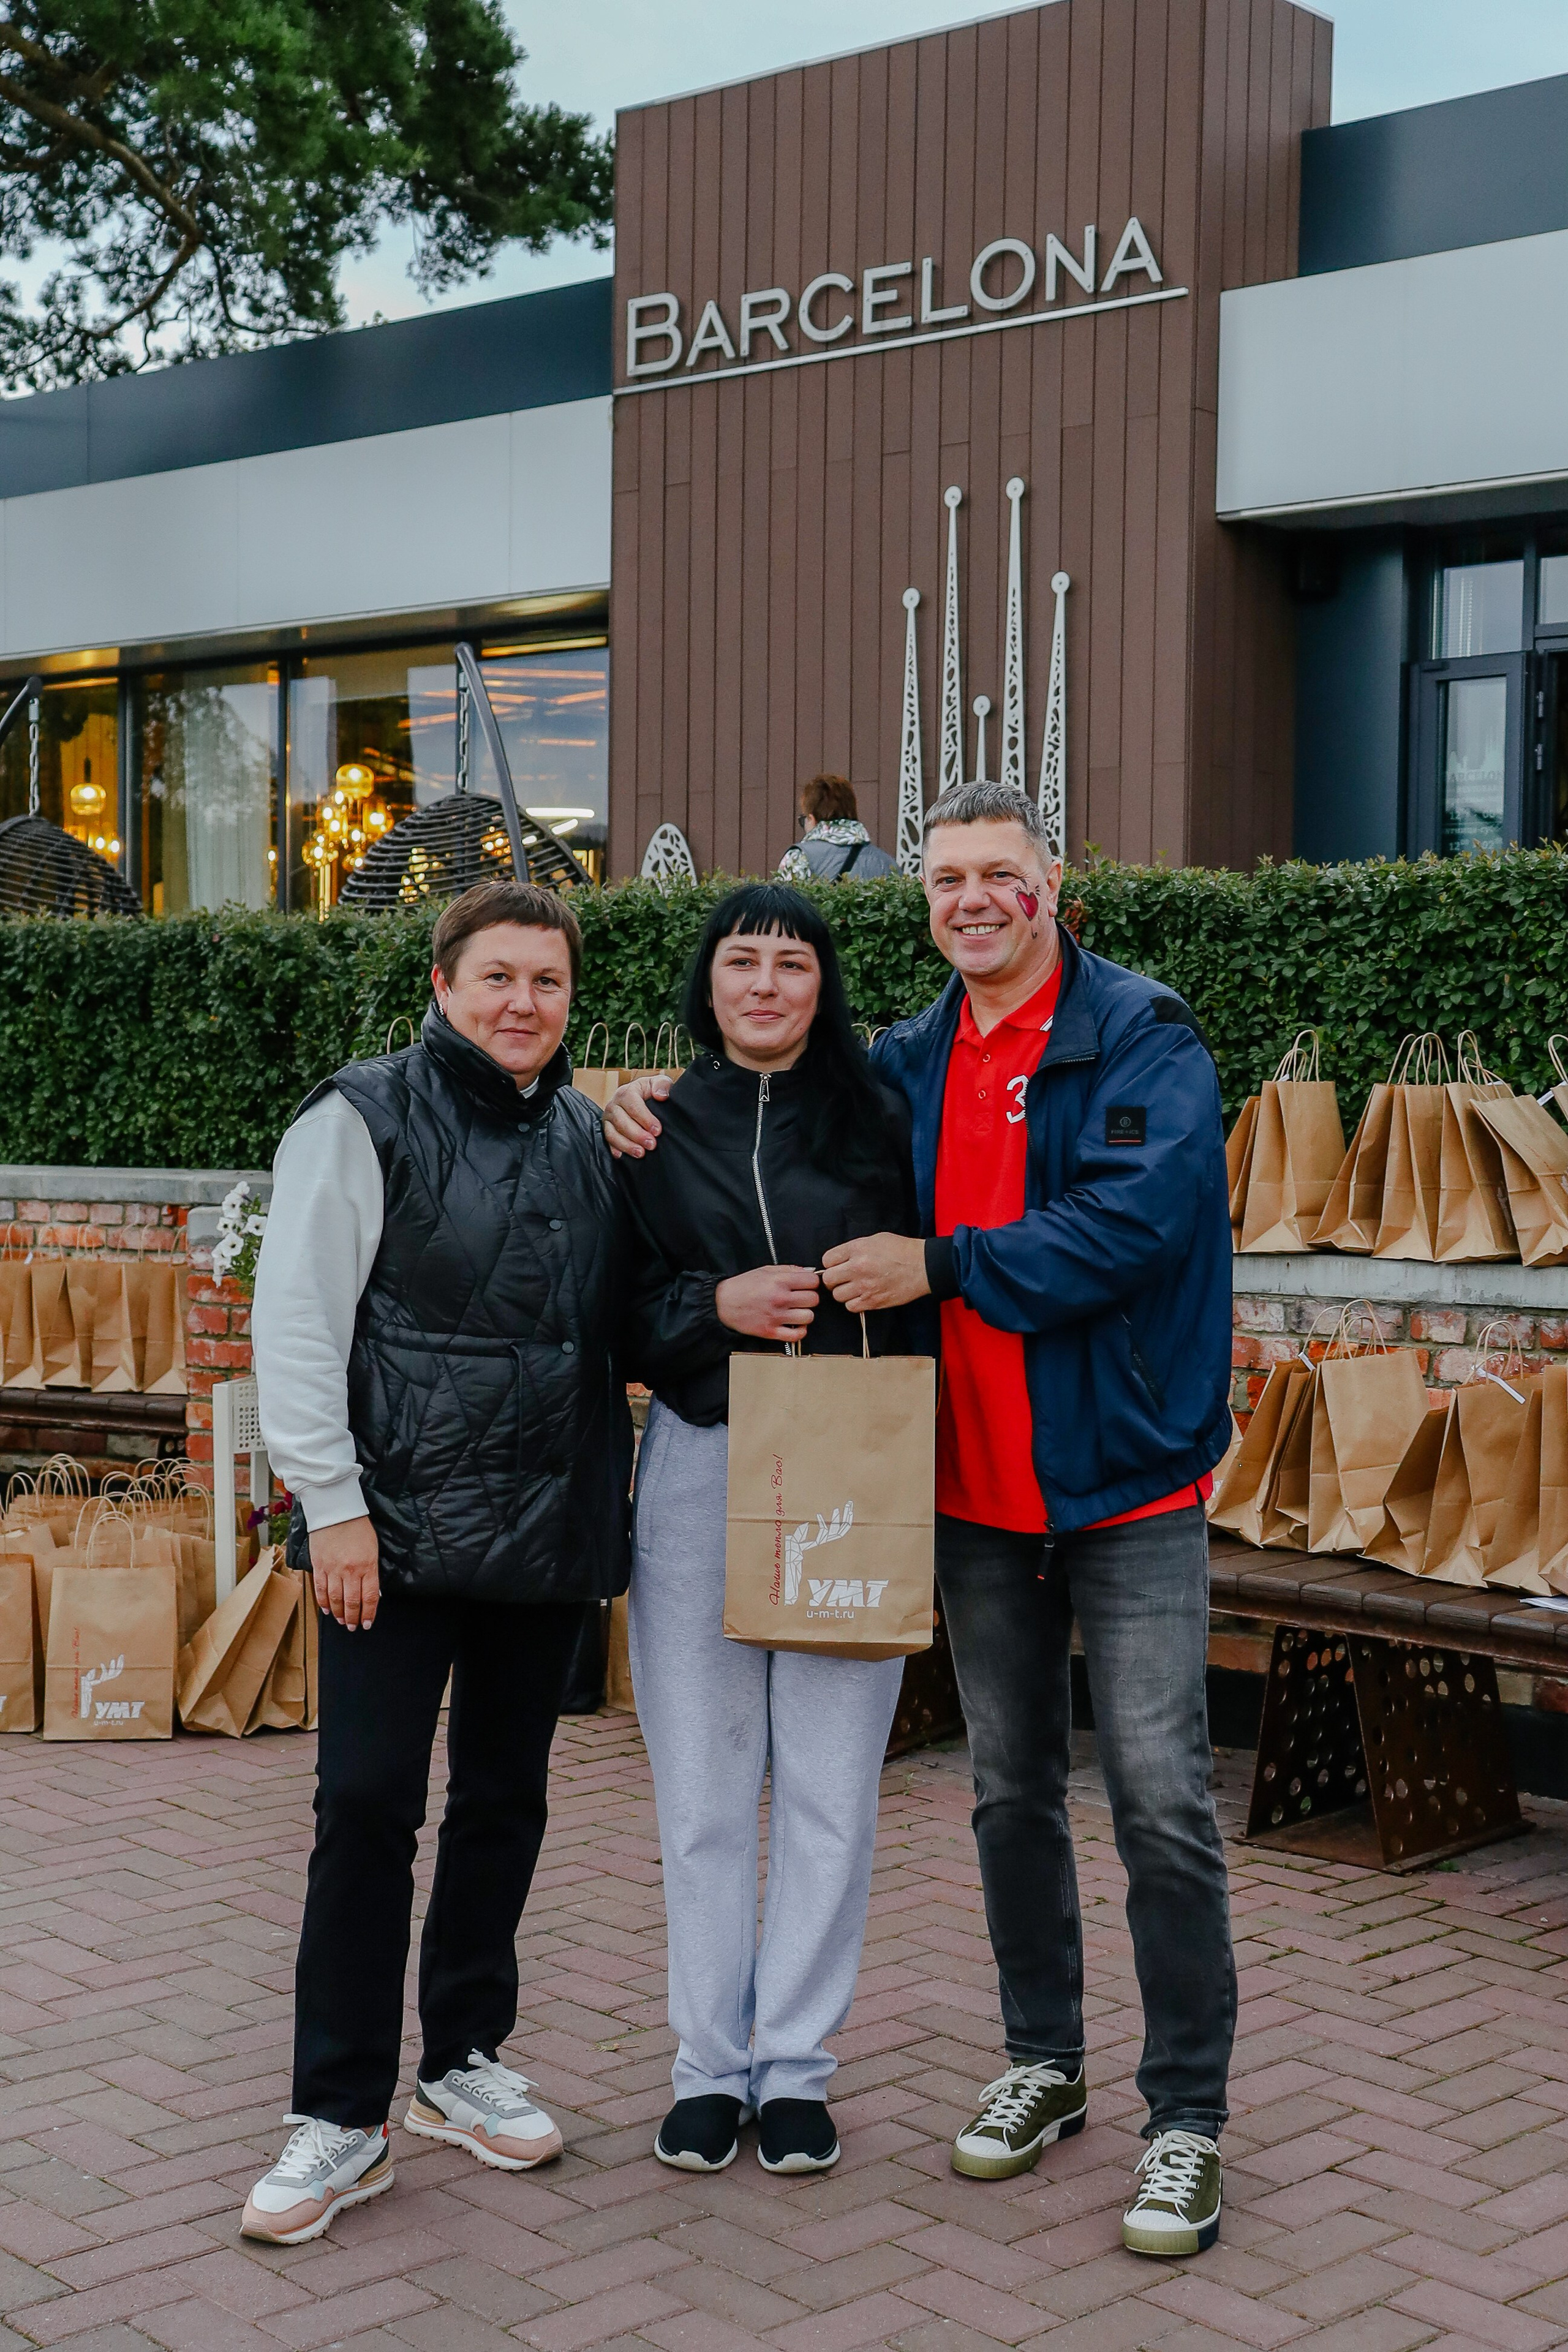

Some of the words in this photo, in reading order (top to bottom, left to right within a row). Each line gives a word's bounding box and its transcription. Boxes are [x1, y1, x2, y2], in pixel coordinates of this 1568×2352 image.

[627, 216, 1163, 377] BARCELONA
[771, 1453, 783, 1490] Вас!
[773, 1493, 785, 1517] для
[773, 1520, 782, 1559] тепло
[769, 1562, 780, 1606] Наше
[807, 1579, 889, 1608] УМТ
[806, 1609, 854, 1619] u-m-t.ru
[94, 1702, 145, 1719] УМТ
